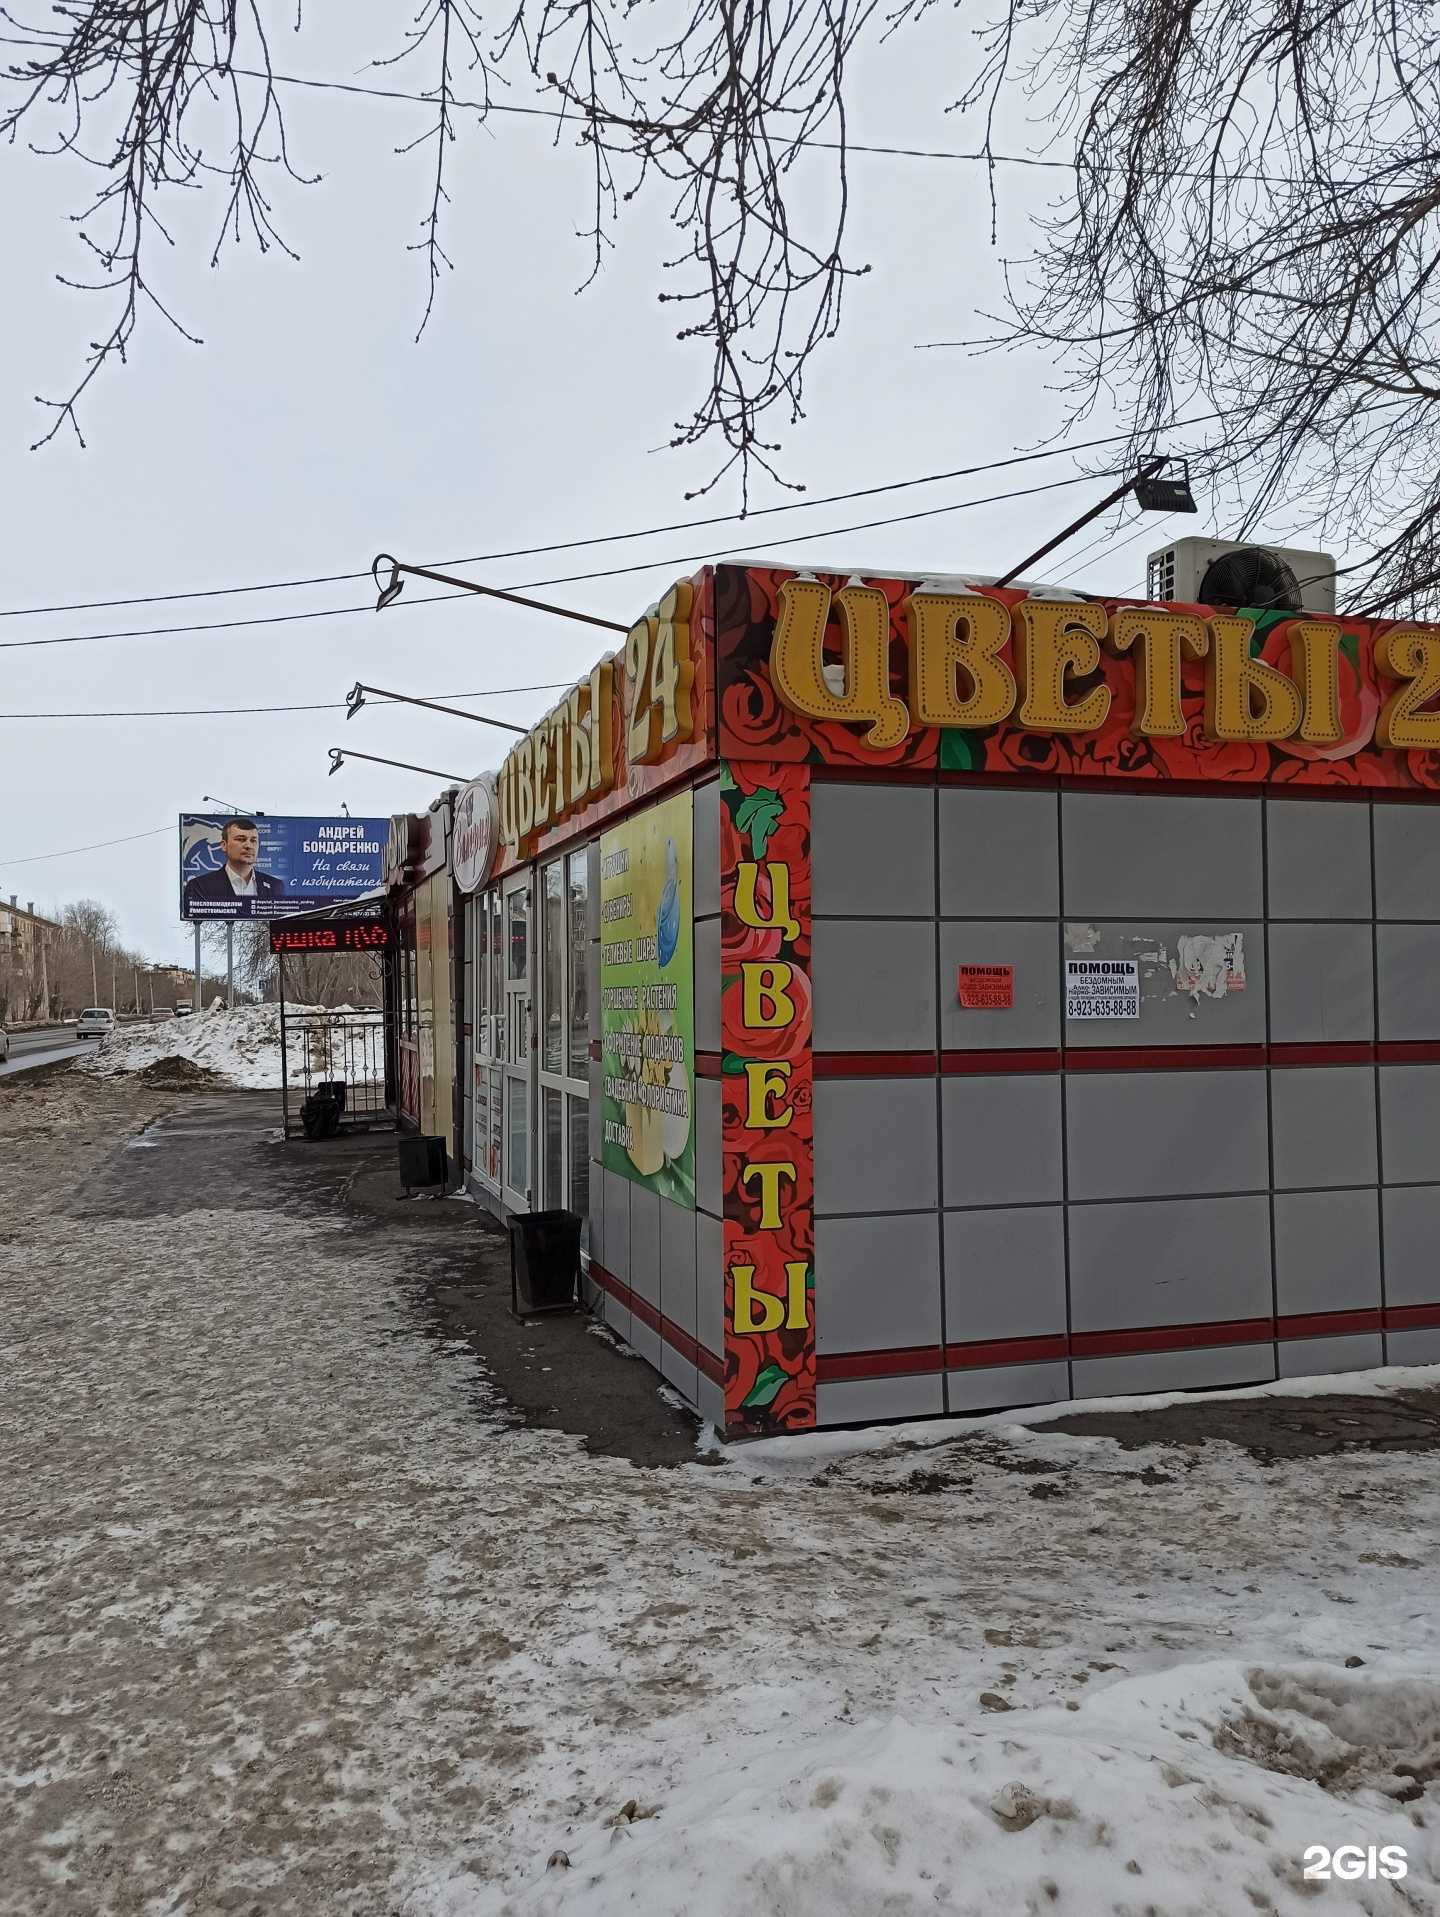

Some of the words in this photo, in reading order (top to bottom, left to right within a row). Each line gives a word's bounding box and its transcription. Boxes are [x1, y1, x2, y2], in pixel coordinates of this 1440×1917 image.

[773, 579, 1344, 749] ЦВЕТЫ
[499, 662, 612, 860] ЦВЕТЫ
[626, 582, 691, 764] 24
[318, 825, 365, 840] АНДРЕЙ
[303, 841, 380, 855] БОНДАРЕНКО
[312, 858, 331, 872] На
[336, 859, 371, 872] связи
[290, 878, 298, 887] с
[961, 966, 1010, 976] ПОМОЩЬ
[1069, 962, 1135, 976] ПОМОЩЬ
[1080, 976, 1125, 985] БЕЗДОМНЫМ
[642, 984, 677, 1010] РАСТЕНИЯ
[1091, 985, 1137, 995] ЗАВИСИМЫМ
[1069, 1000, 1137, 1016] 8-923-635-88-88
[646, 1035, 684, 1063] ПОДАРКОВ
[605, 1077, 638, 1104] СВАДЕБНАЯ
[641, 1083, 689, 1118] ФЛОРИСТИКА
[733, 862, 810, 1336] ЦВЕТЫ
[604, 1120, 635, 1151] ДОСТАВКА
